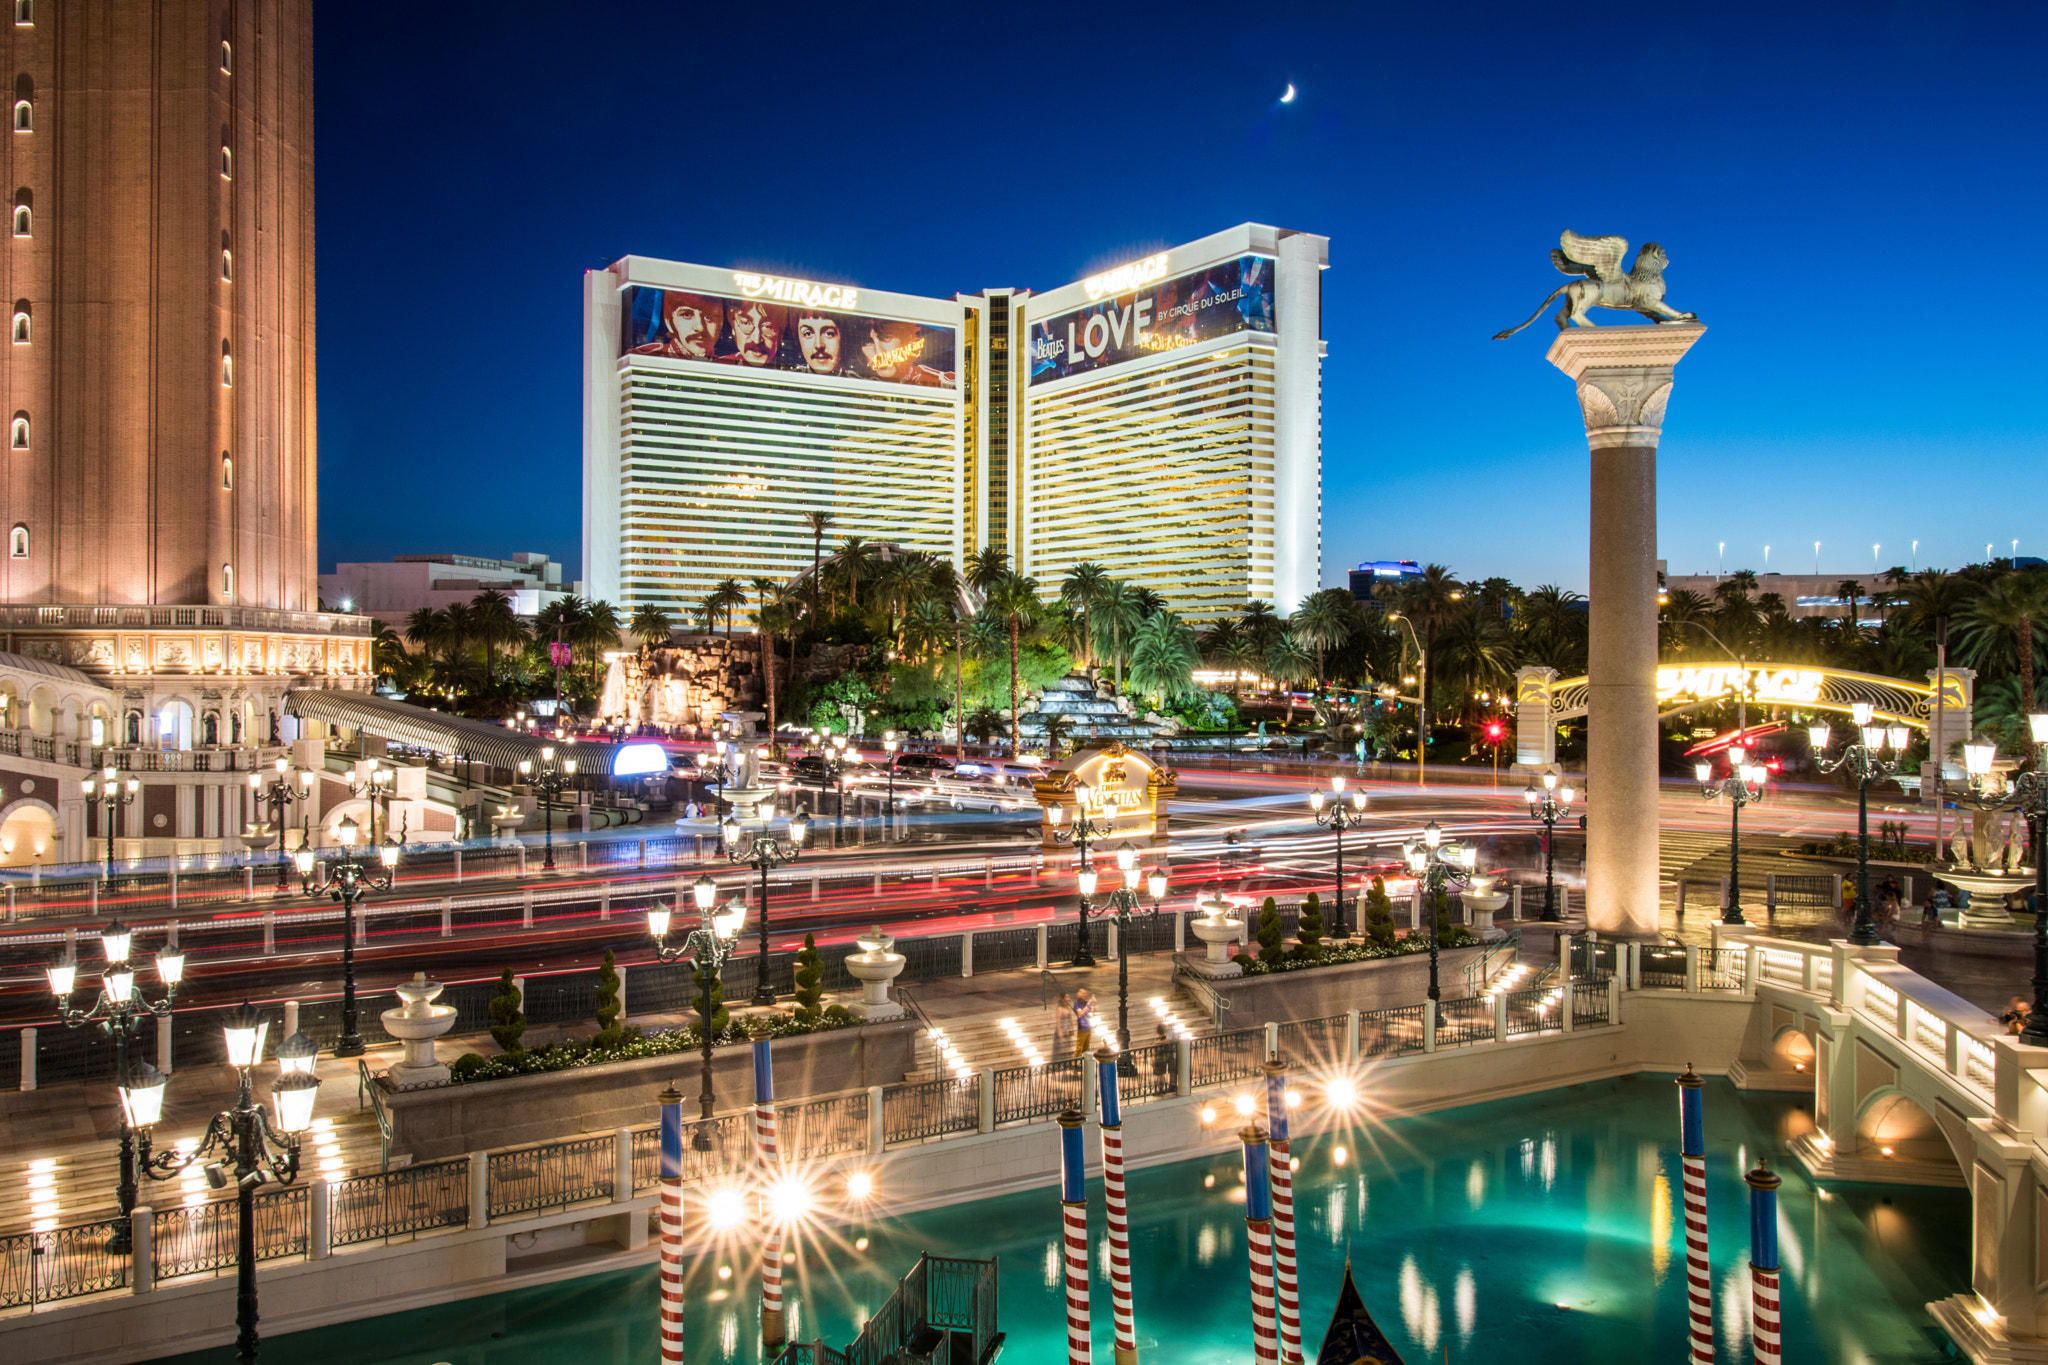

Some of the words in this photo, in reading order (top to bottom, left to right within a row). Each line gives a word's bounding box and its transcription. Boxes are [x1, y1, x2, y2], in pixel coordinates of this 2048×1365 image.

[733, 273, 762, 288] THE
[1089, 254, 1168, 301] MIRAGE
[742, 278, 858, 309] MIRAGE
[1157, 309, 1168, 322] BY
[1168, 301, 1199, 317] CIRQUE
[1200, 296, 1213, 309] DU
[1068, 298, 1153, 365] LOVE
[1037, 337, 1065, 360] BEATLES
[1101, 784, 1114, 792] THE
